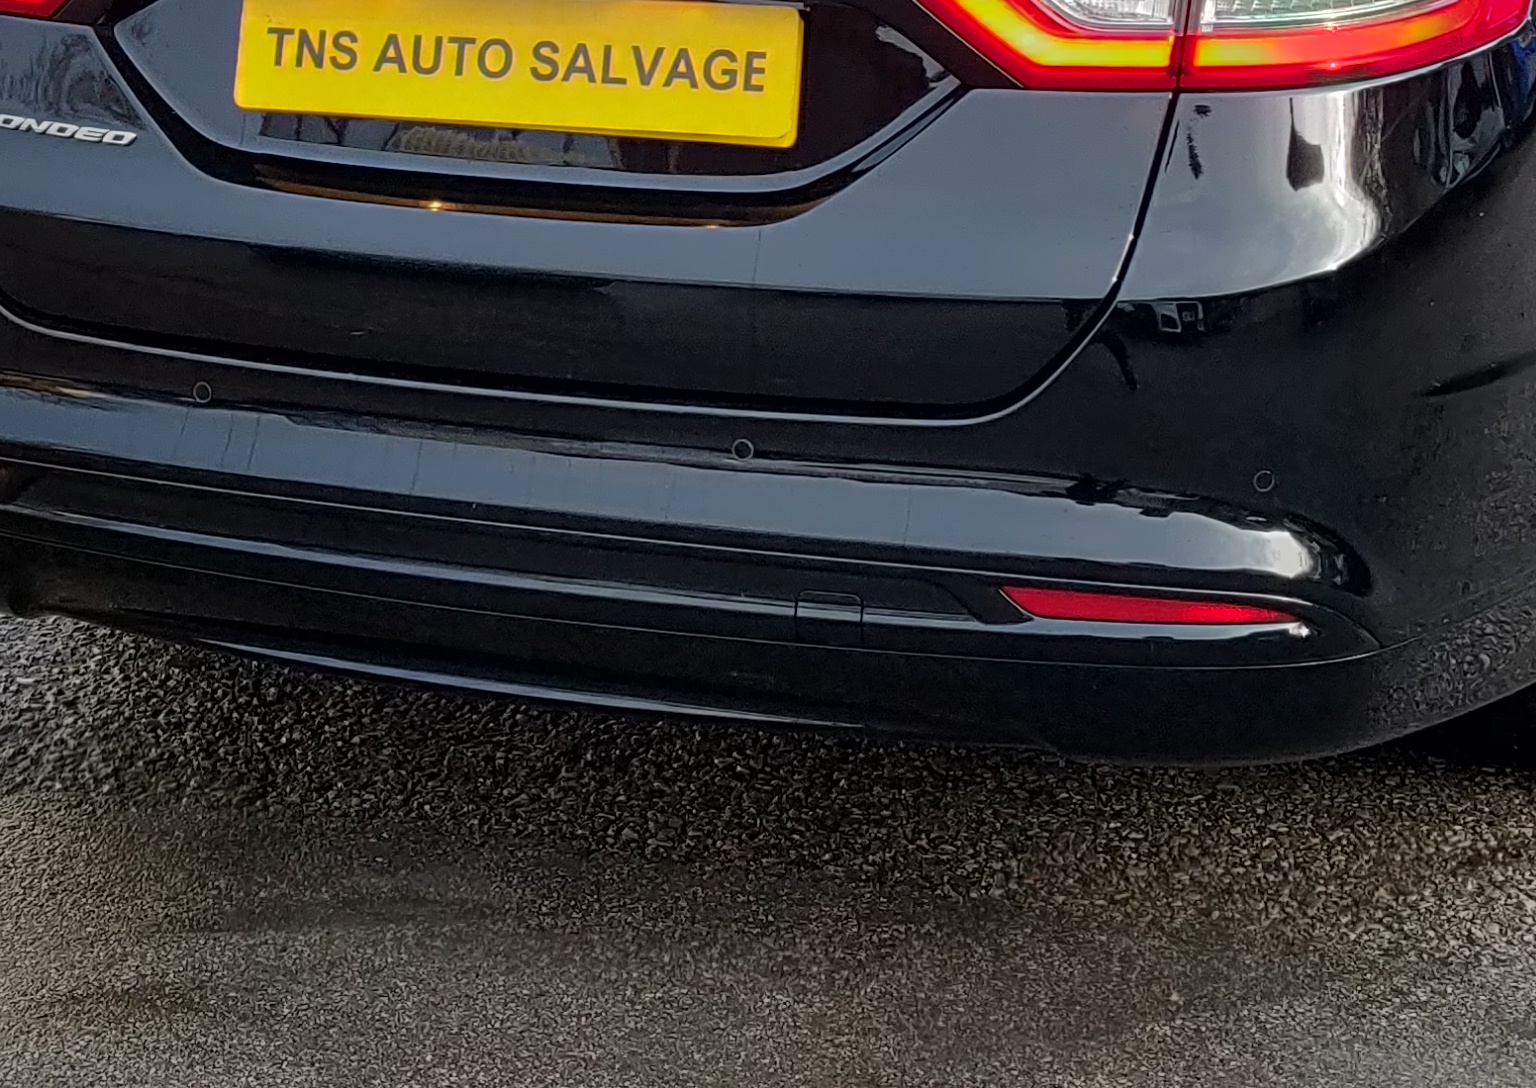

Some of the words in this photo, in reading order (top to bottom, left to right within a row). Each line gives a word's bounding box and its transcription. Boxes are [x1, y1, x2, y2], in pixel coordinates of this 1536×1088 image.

[266, 26, 359, 72] TNS
[372, 33, 514, 80] AUTO
[528, 39, 767, 93] SALVAGE
